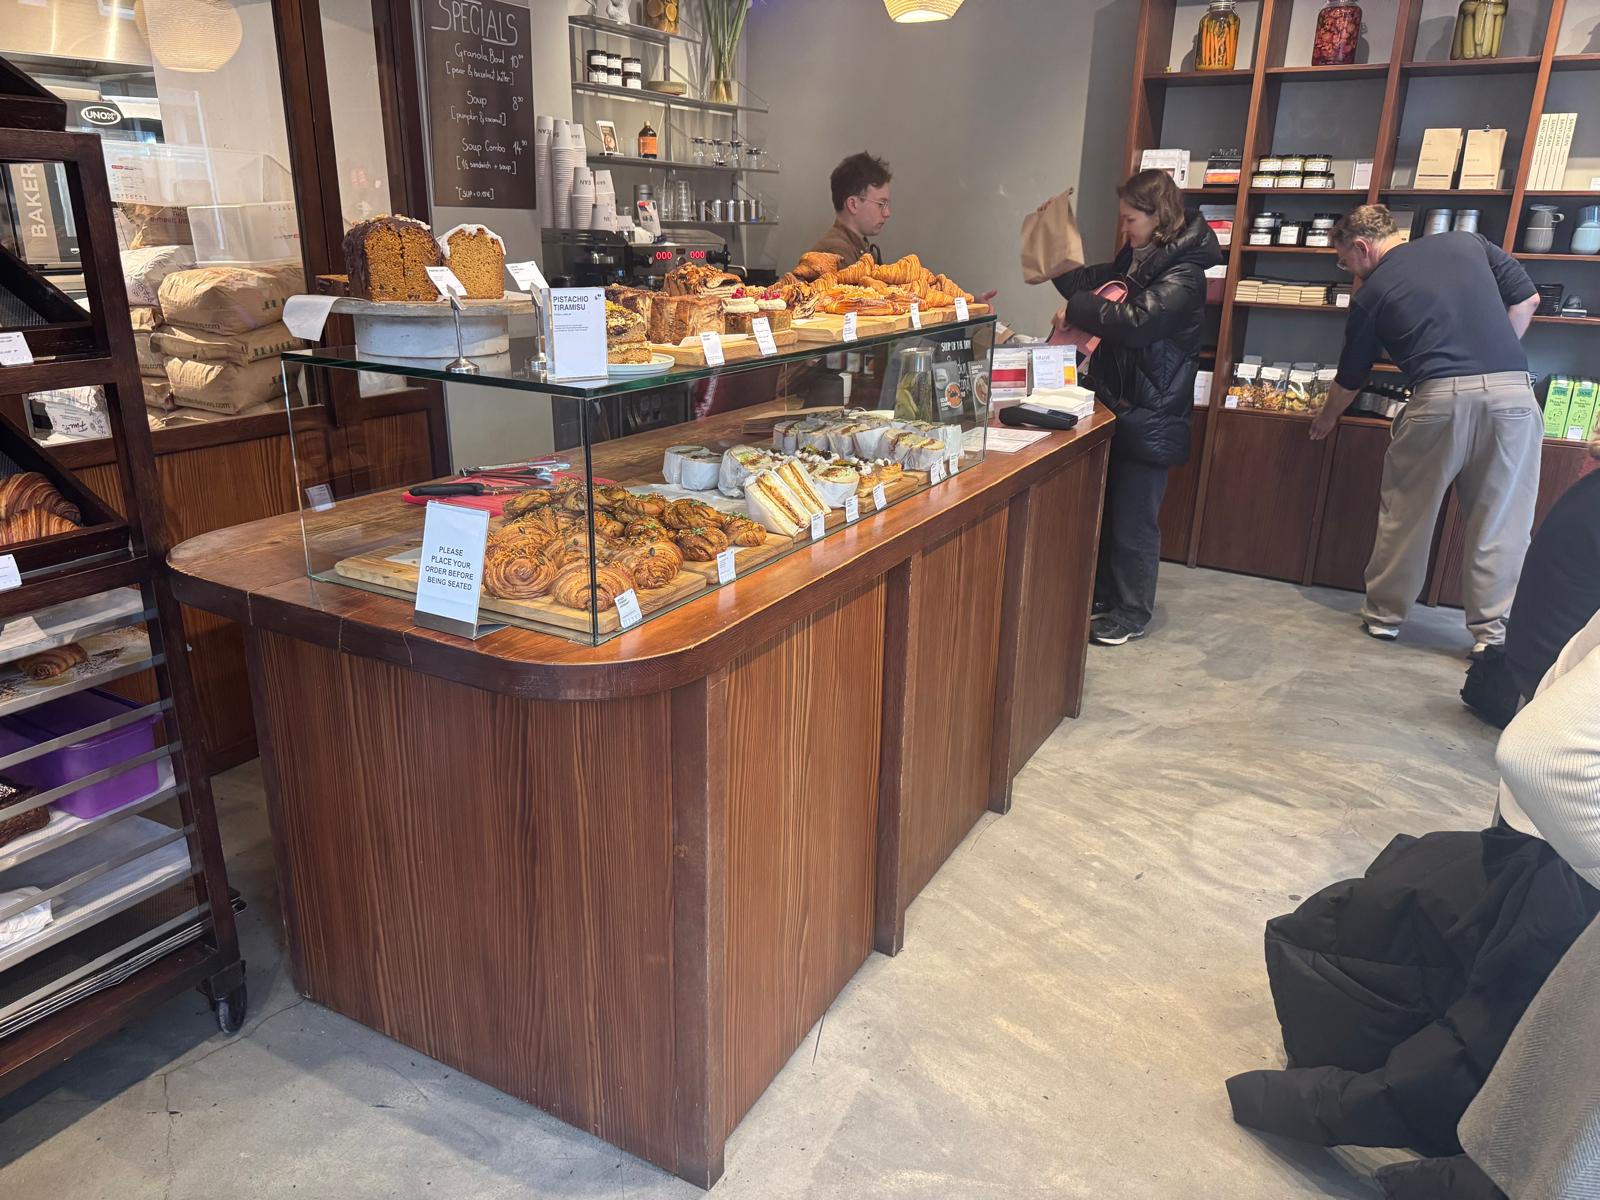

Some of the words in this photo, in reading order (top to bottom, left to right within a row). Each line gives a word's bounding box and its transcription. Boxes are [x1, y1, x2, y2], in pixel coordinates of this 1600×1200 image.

[431, 0, 518, 46] SPECIALS
[455, 42, 488, 62] Granola
[467, 90, 487, 108] Soup
[85, 110, 115, 120] UNOX
[461, 137, 482, 157] Soup
[484, 140, 506, 153] Combo
[656, 251, 673, 260] 000
[690, 250, 705, 259] 000
[553, 295, 589, 303] PISTACHIO
[553, 303, 586, 311] TIRAMISU
[439, 546, 463, 557] PLEASE
[431, 555, 452, 566] PLACE
[453, 560, 471, 570] YOUR
[425, 565, 447, 576] ORDER
[448, 569, 474, 580] BEFORE
[427, 576, 446, 586] BEING
[447, 580, 473, 591] SEATED
